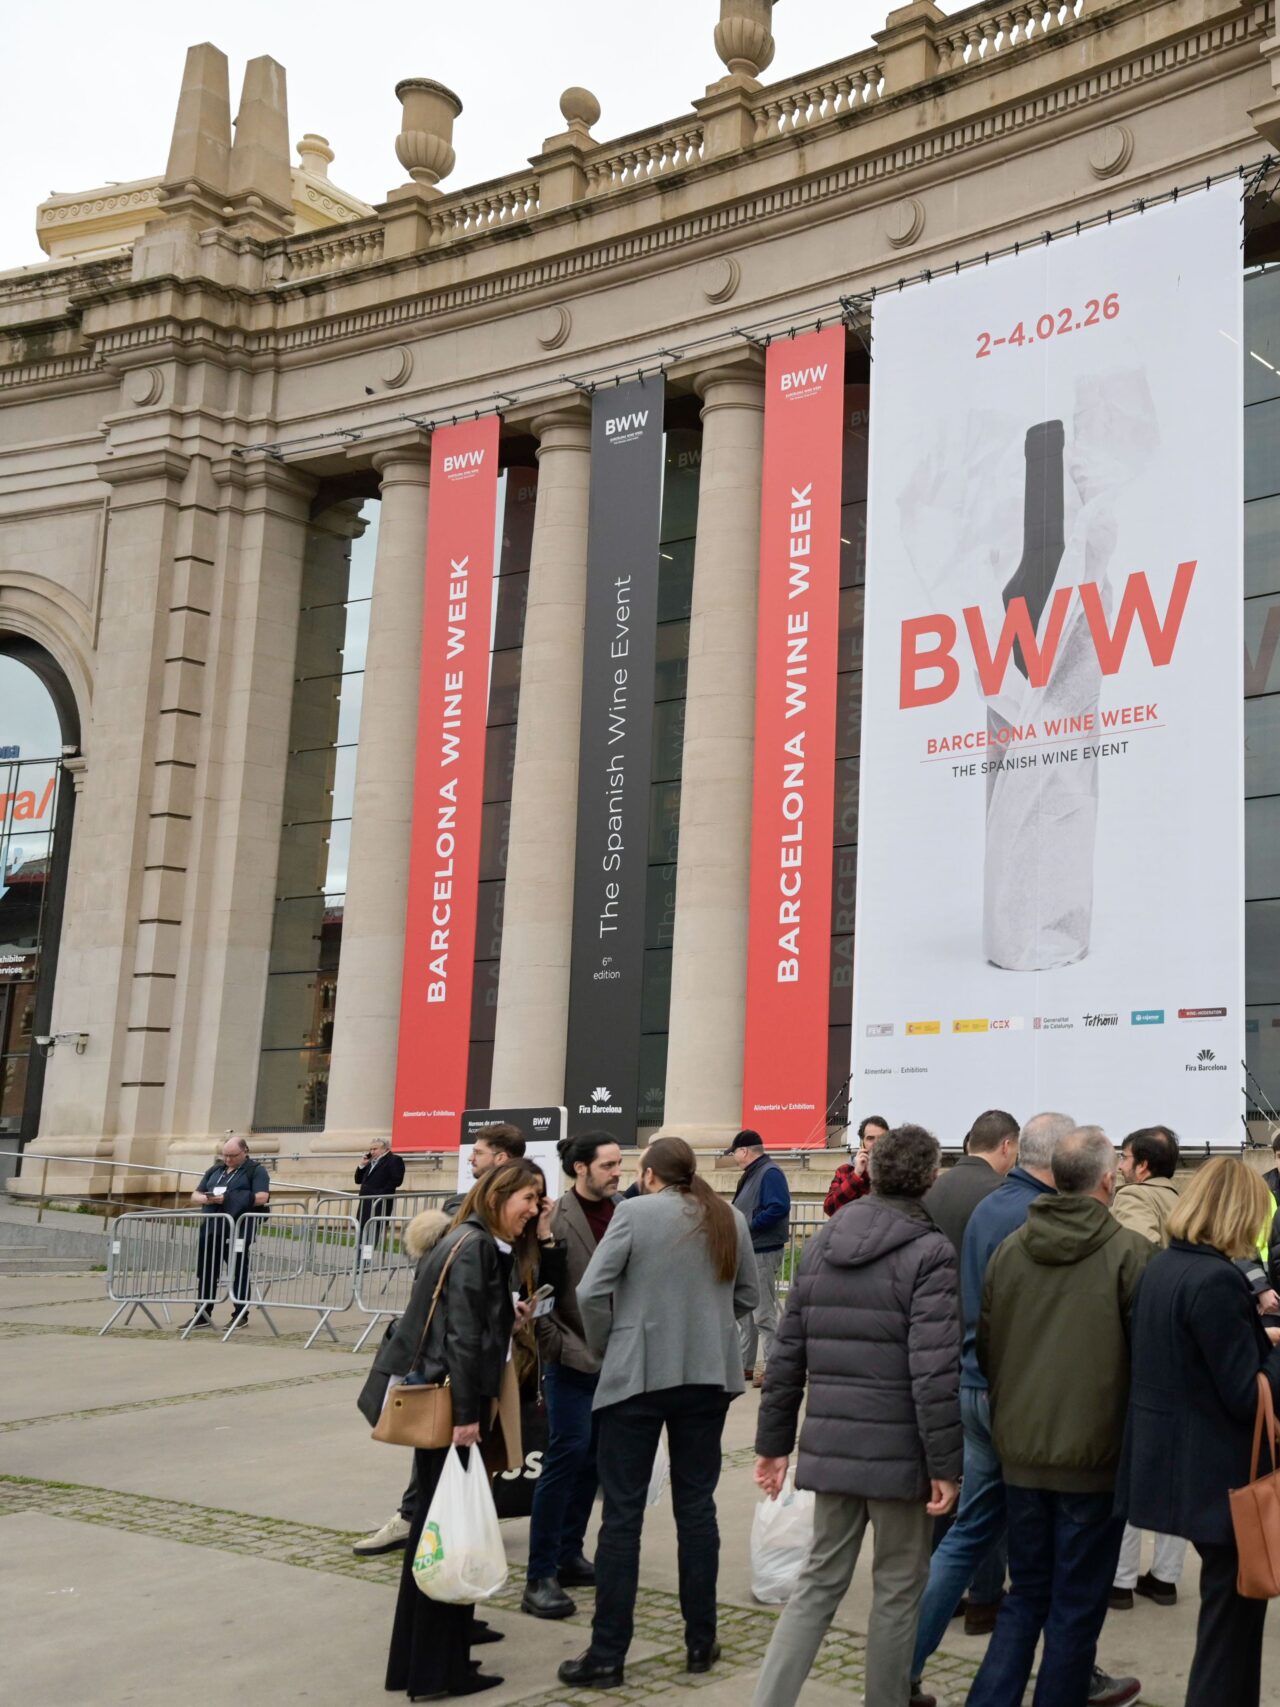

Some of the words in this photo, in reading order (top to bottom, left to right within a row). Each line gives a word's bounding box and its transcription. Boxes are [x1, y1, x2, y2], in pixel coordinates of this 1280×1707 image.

[976, 293, 1119, 358] 2-4.02.26
[780, 364, 828, 391] BWW
[605, 410, 649, 435] BWW
[444, 449, 485, 472] BWW
[789, 483, 812, 599] WEEK
[446, 556, 469, 659] WEEK
[611, 575, 632, 658] Event
[899, 561, 1197, 710] BWW
[786, 612, 809, 719] WINE
[441, 671, 463, 766] WINE
[606, 669, 628, 745] Wine
[928, 723, 1037, 755] BARCELONA
[1044, 712, 1096, 737] WINE
[1101, 703, 1158, 728] WEEK
[952, 764, 976, 779] THE
[981, 754, 1037, 775] SPANISH
[1042, 749, 1079, 766] WINE
[1085, 741, 1129, 762] EVENT
[602, 755, 628, 871] Spanish
[778, 731, 805, 983] BARCELONA
[427, 778, 458, 1003] BARCELONA
[600, 883, 620, 938] The
[593, 970, 620, 980] edition
[901, 1066, 928, 1074] Exhibitions
[1185, 1064, 1197, 1072] Fira
[1198, 1063, 1227, 1071] Barcelona
[533, 1117, 551, 1126] BWW
[579, 1105, 591, 1114] Fira
[592, 1104, 622, 1114] Barcelona
